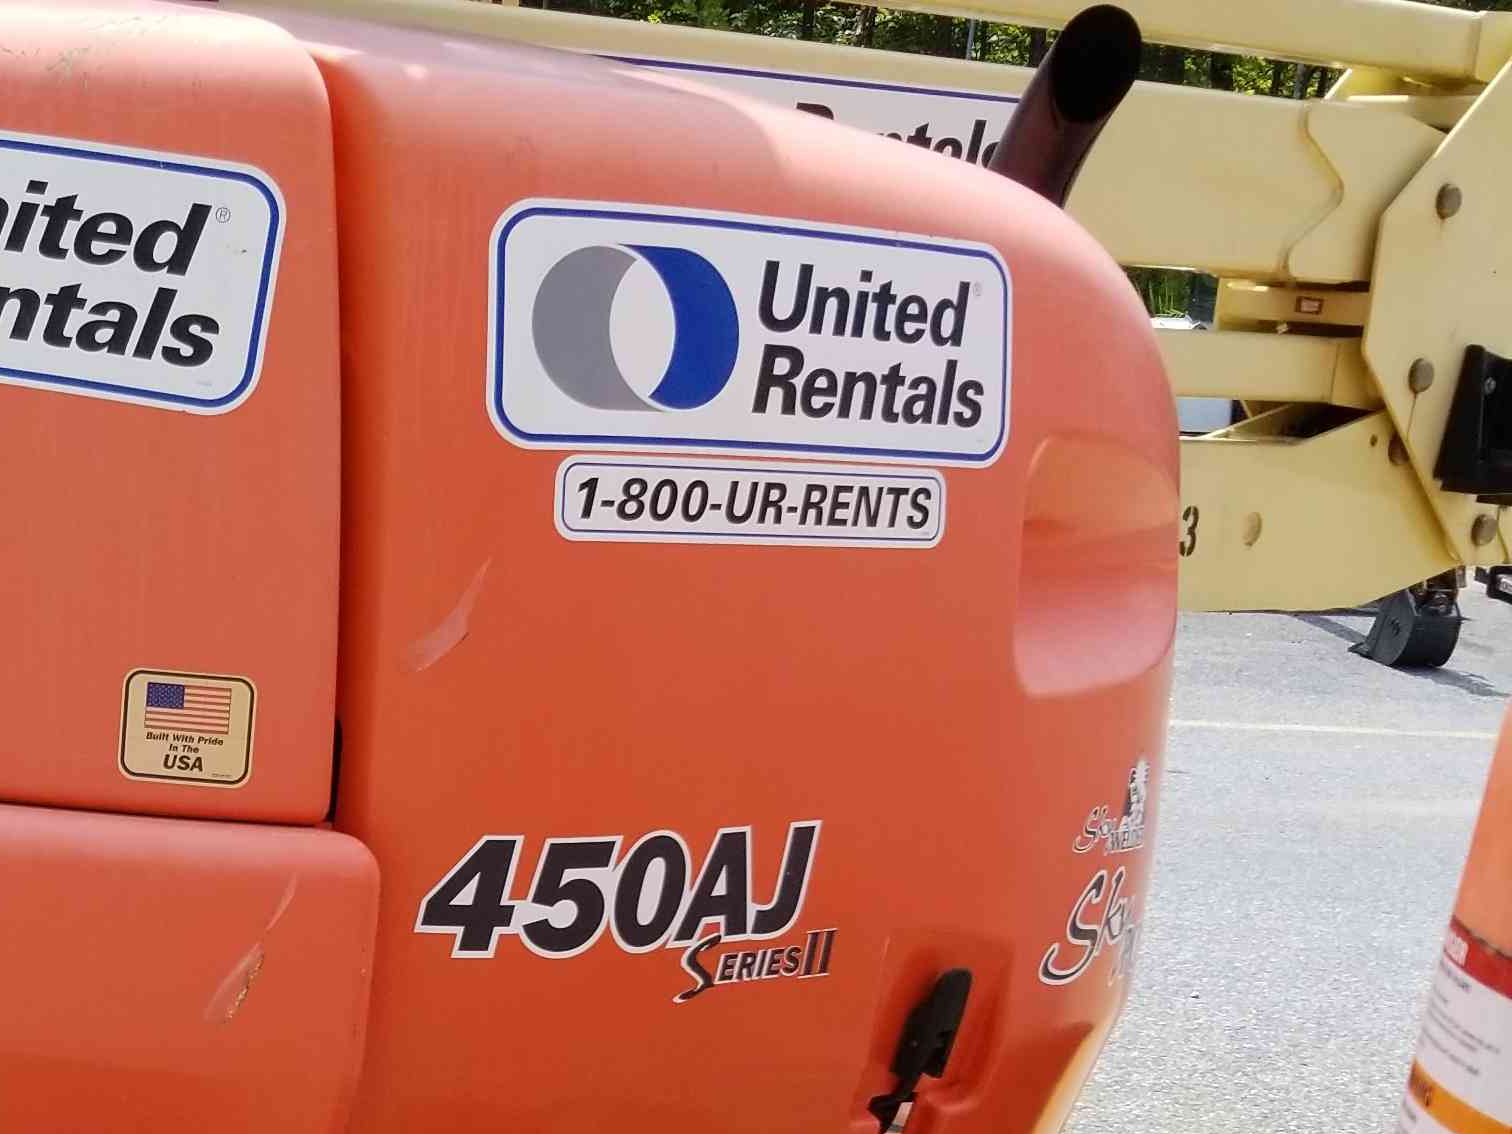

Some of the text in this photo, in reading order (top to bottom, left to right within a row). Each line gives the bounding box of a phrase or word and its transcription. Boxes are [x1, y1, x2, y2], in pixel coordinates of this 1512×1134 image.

[757, 259, 972, 348] United
[751, 343, 986, 429] Rentals
[576, 477, 933, 530] 1-800-UR-RENTS
[145, 731, 224, 746] Built With Pride
[163, 754, 204, 772] USA
[168, 743, 200, 754] In The
[416, 820, 821, 958] 450AJ
